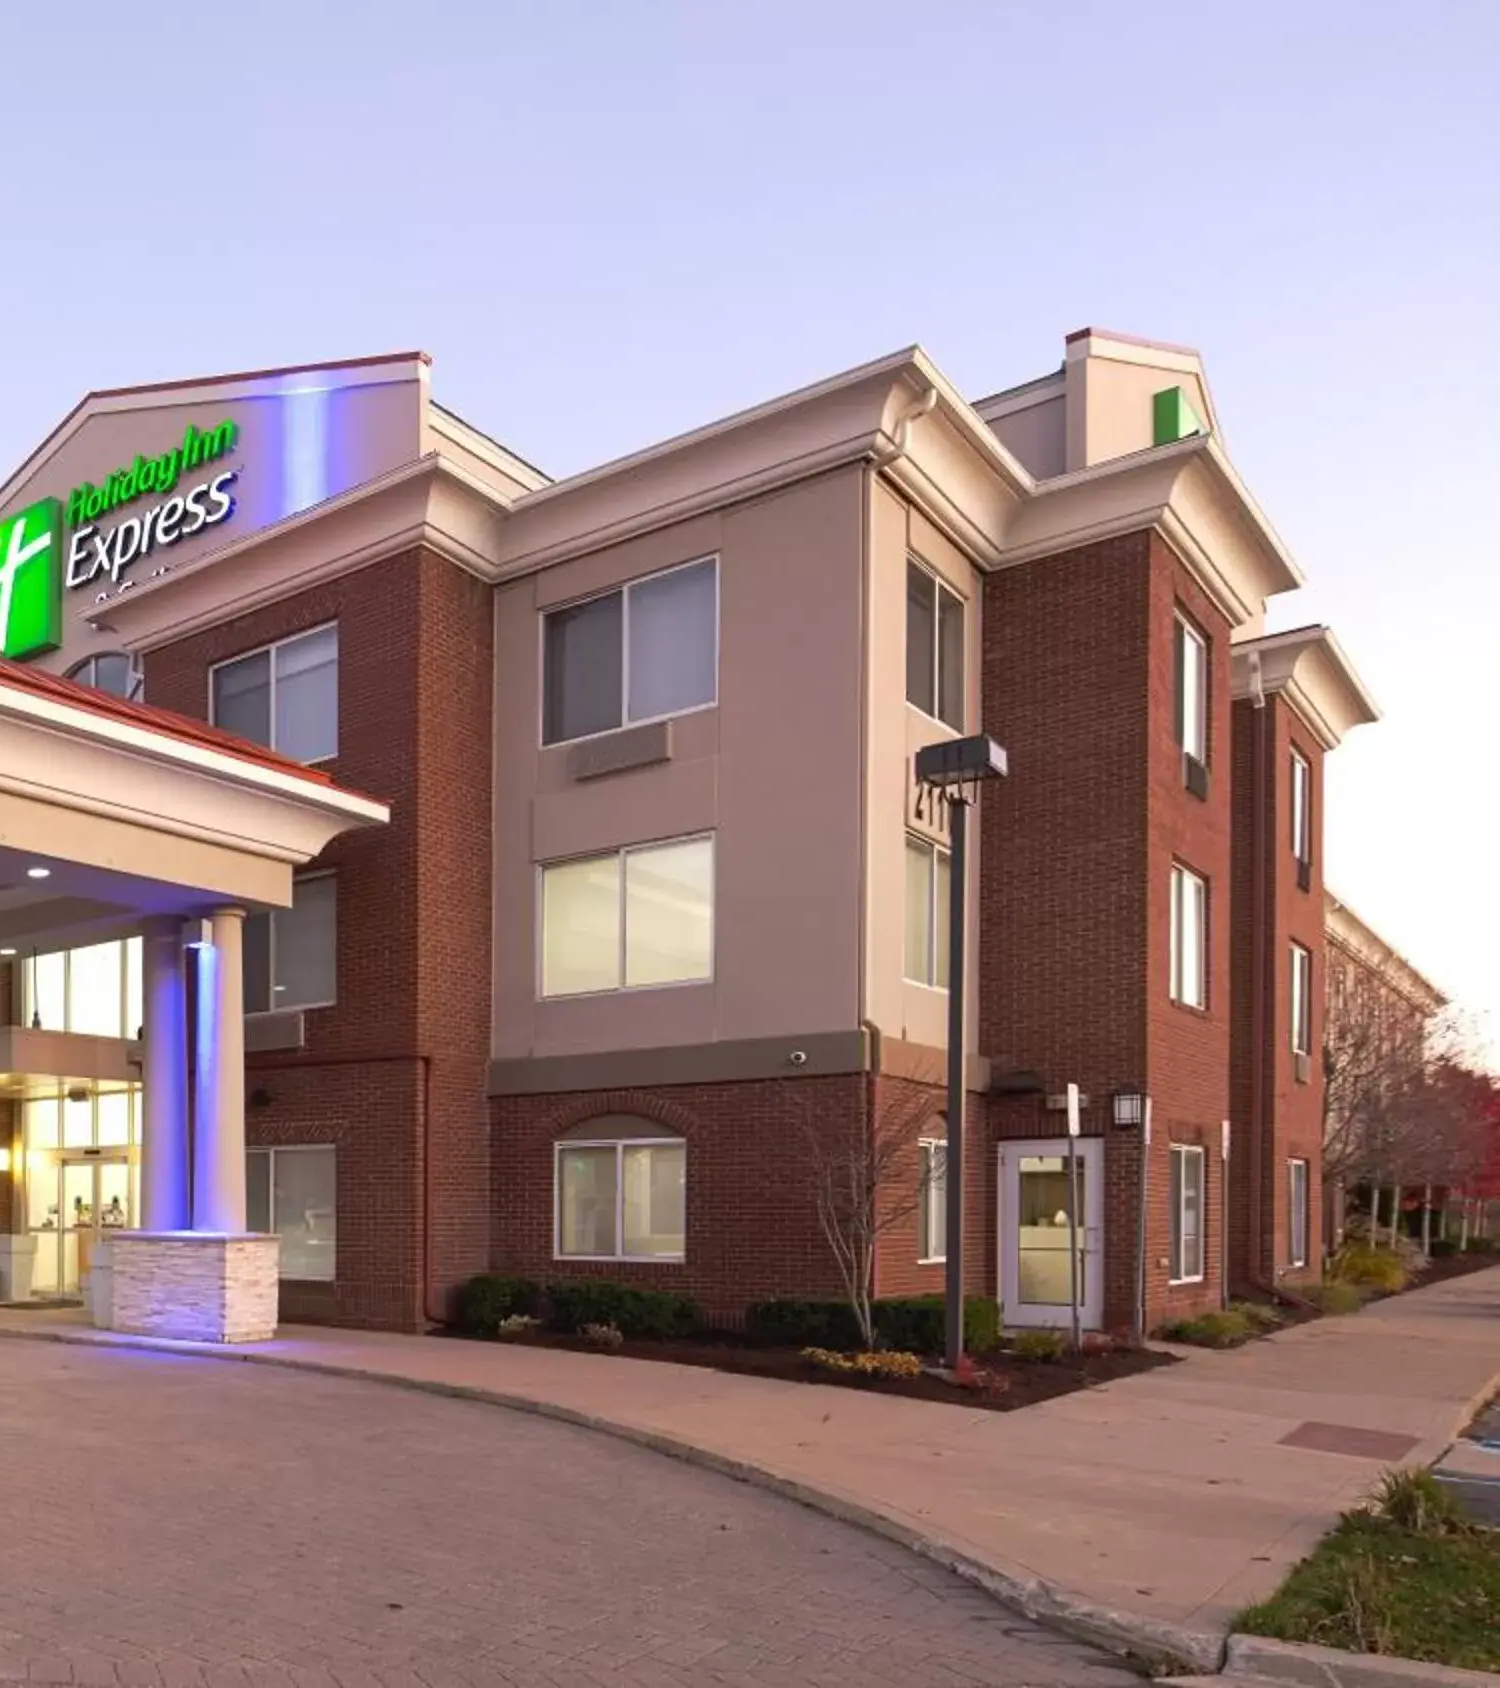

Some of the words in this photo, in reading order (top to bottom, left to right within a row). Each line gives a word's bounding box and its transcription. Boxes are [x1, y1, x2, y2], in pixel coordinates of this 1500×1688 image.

[66, 447, 181, 526] Holiday
[182, 418, 237, 469] Inn
[66, 471, 236, 588] Express
